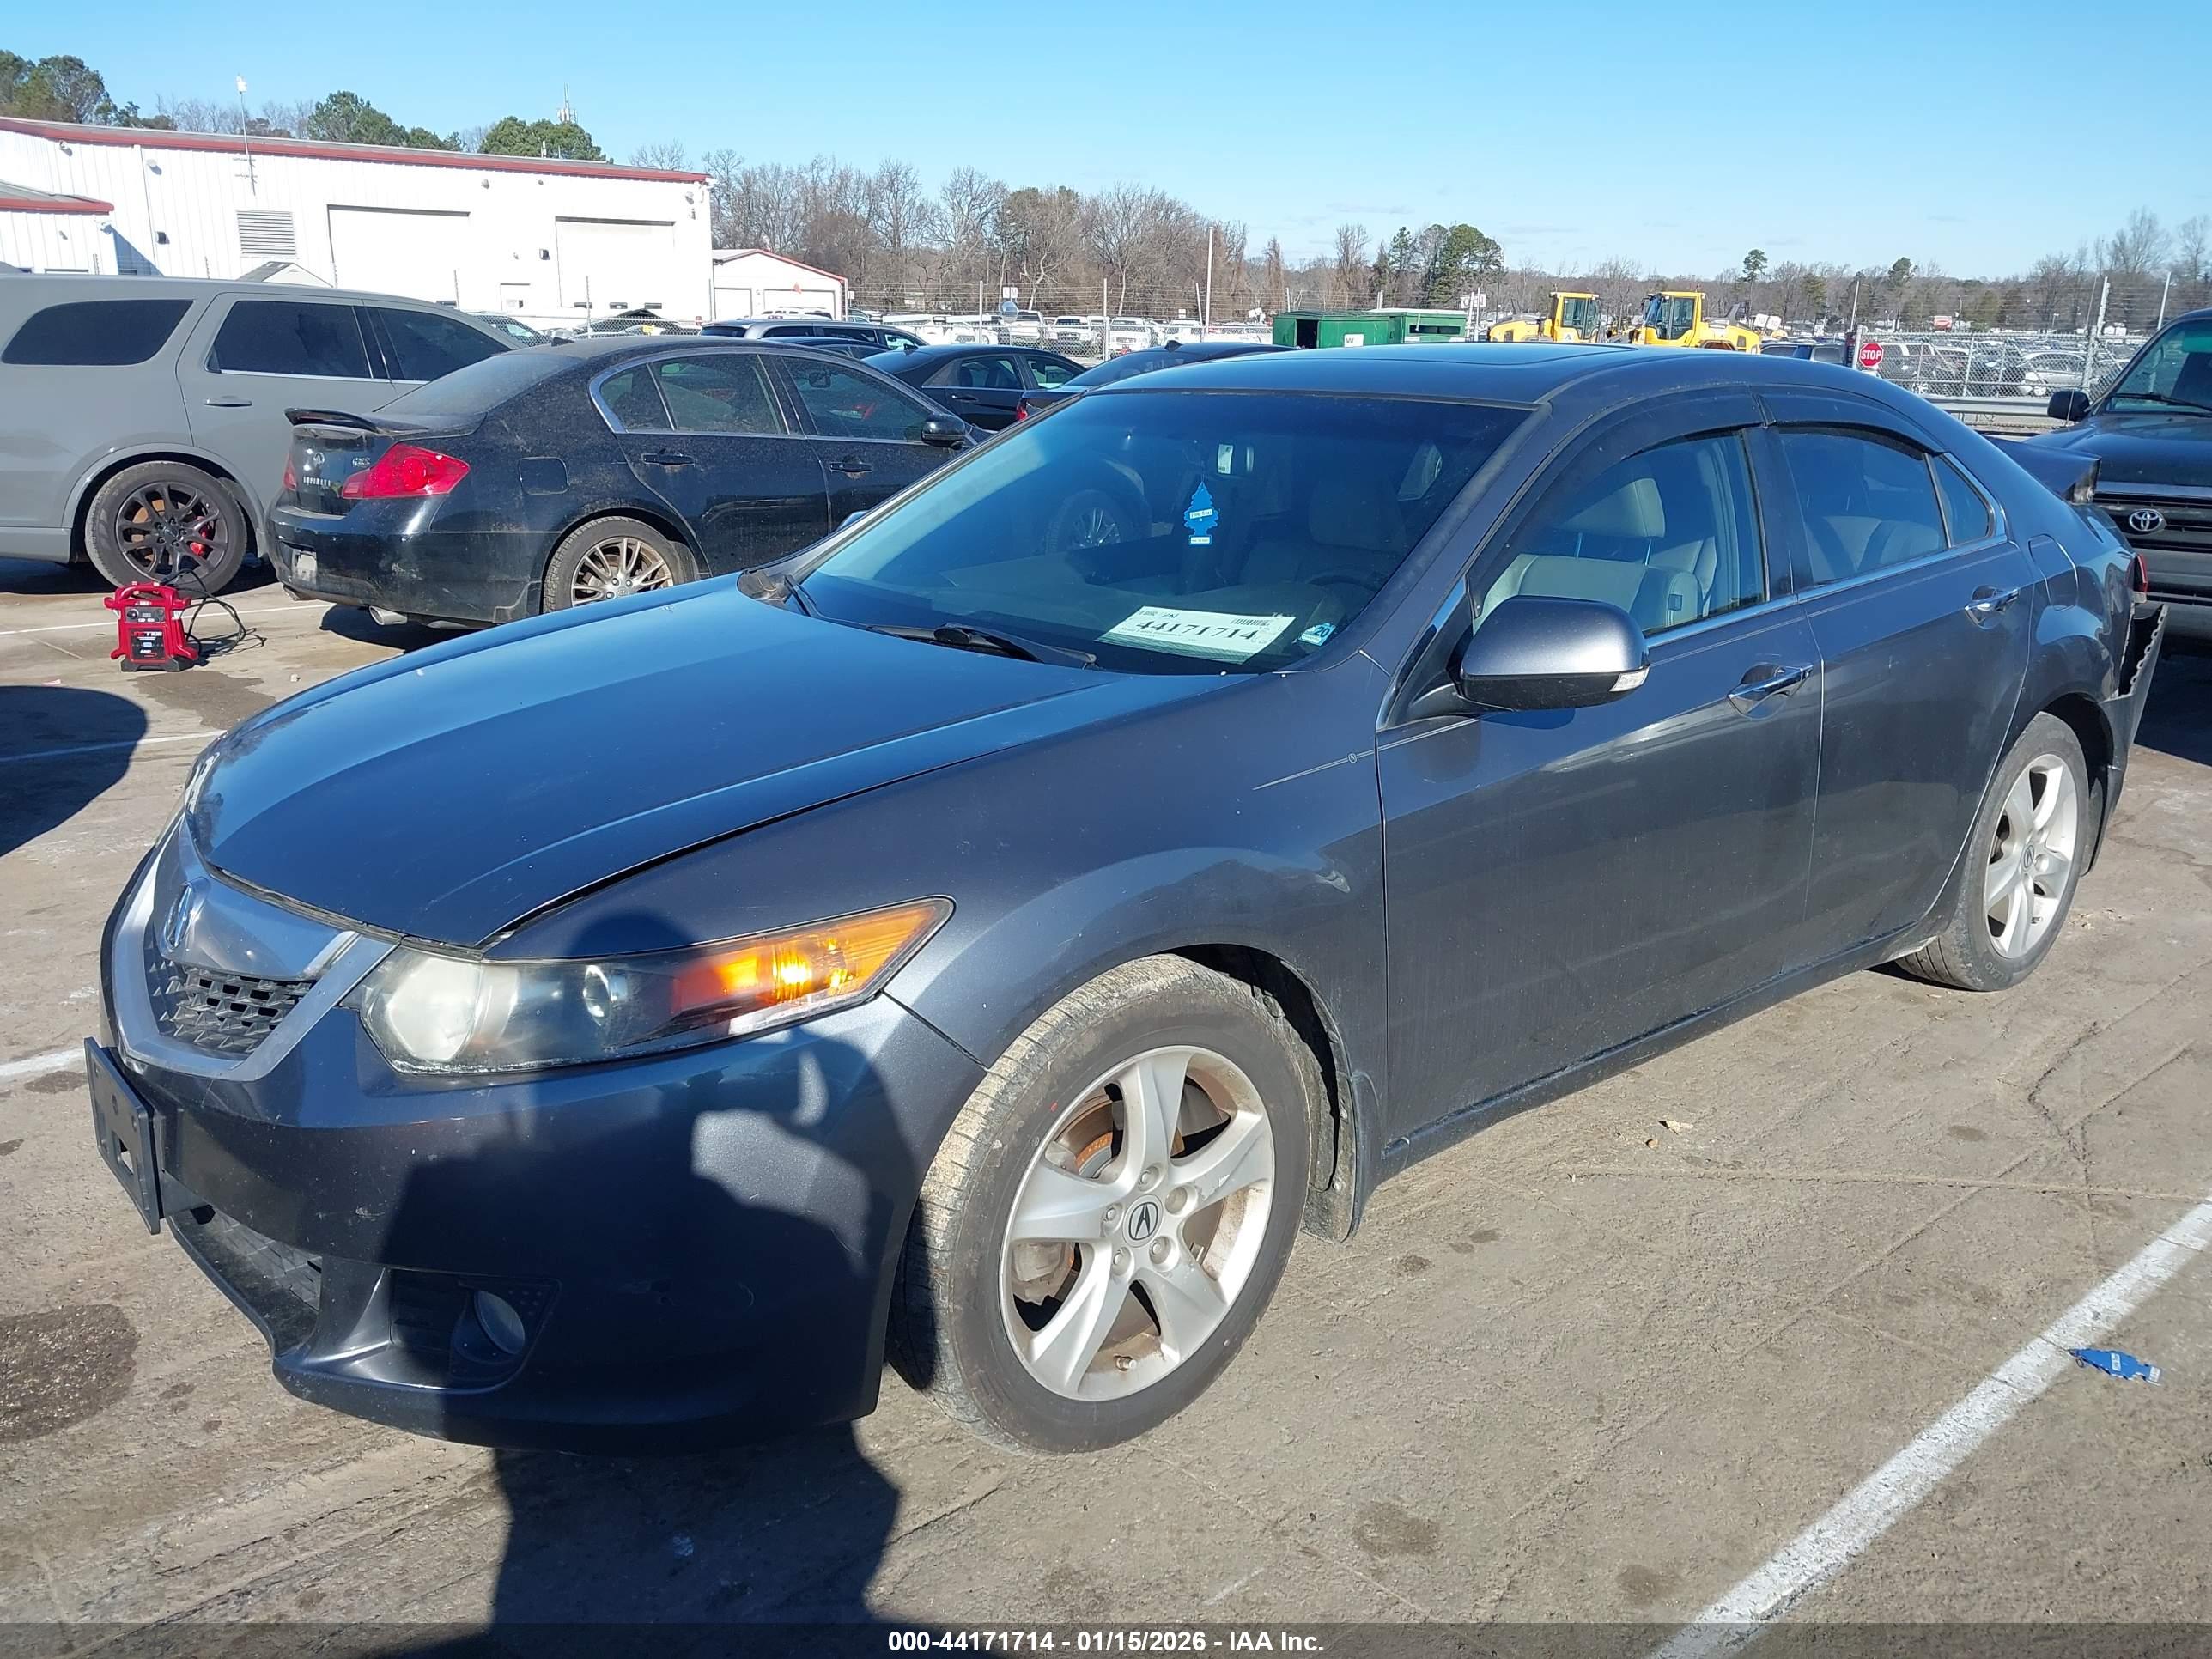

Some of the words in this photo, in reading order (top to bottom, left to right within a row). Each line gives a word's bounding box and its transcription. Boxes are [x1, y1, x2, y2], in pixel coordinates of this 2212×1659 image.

[1861, 350, 1882, 360] STOP
[1136, 620, 1259, 640] 44171714
[1314, 625, 1330, 638] 20
